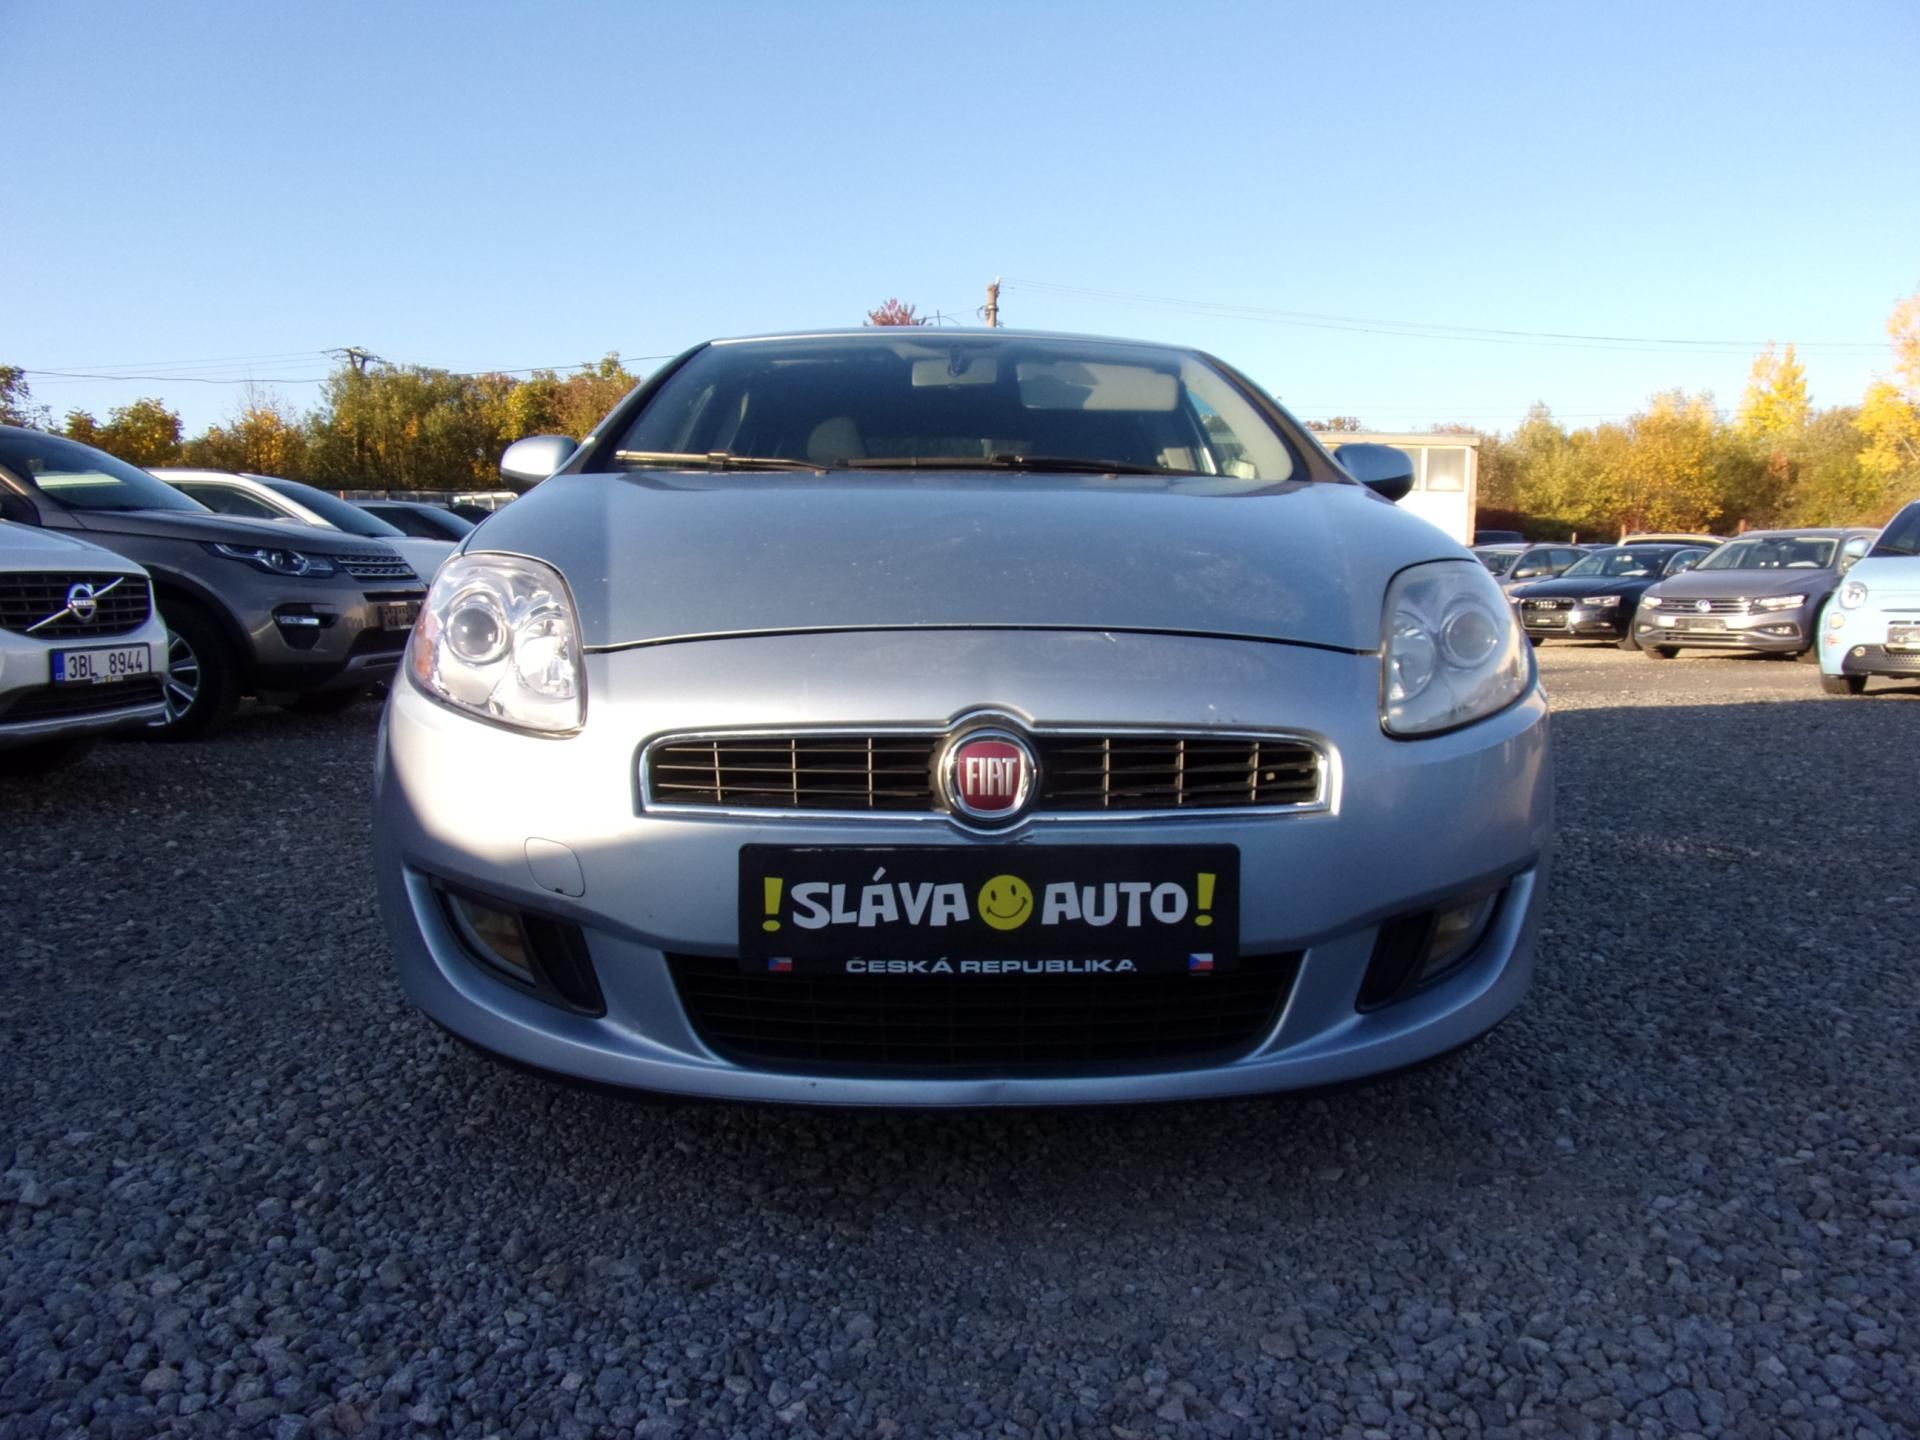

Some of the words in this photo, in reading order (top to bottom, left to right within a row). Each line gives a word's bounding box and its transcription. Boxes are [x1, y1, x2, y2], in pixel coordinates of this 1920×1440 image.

[68, 654, 98, 678] 3BL
[108, 650, 143, 674] 8944
[966, 757, 1017, 796] FIAT
[846, 956, 954, 974] ČESKÁ
